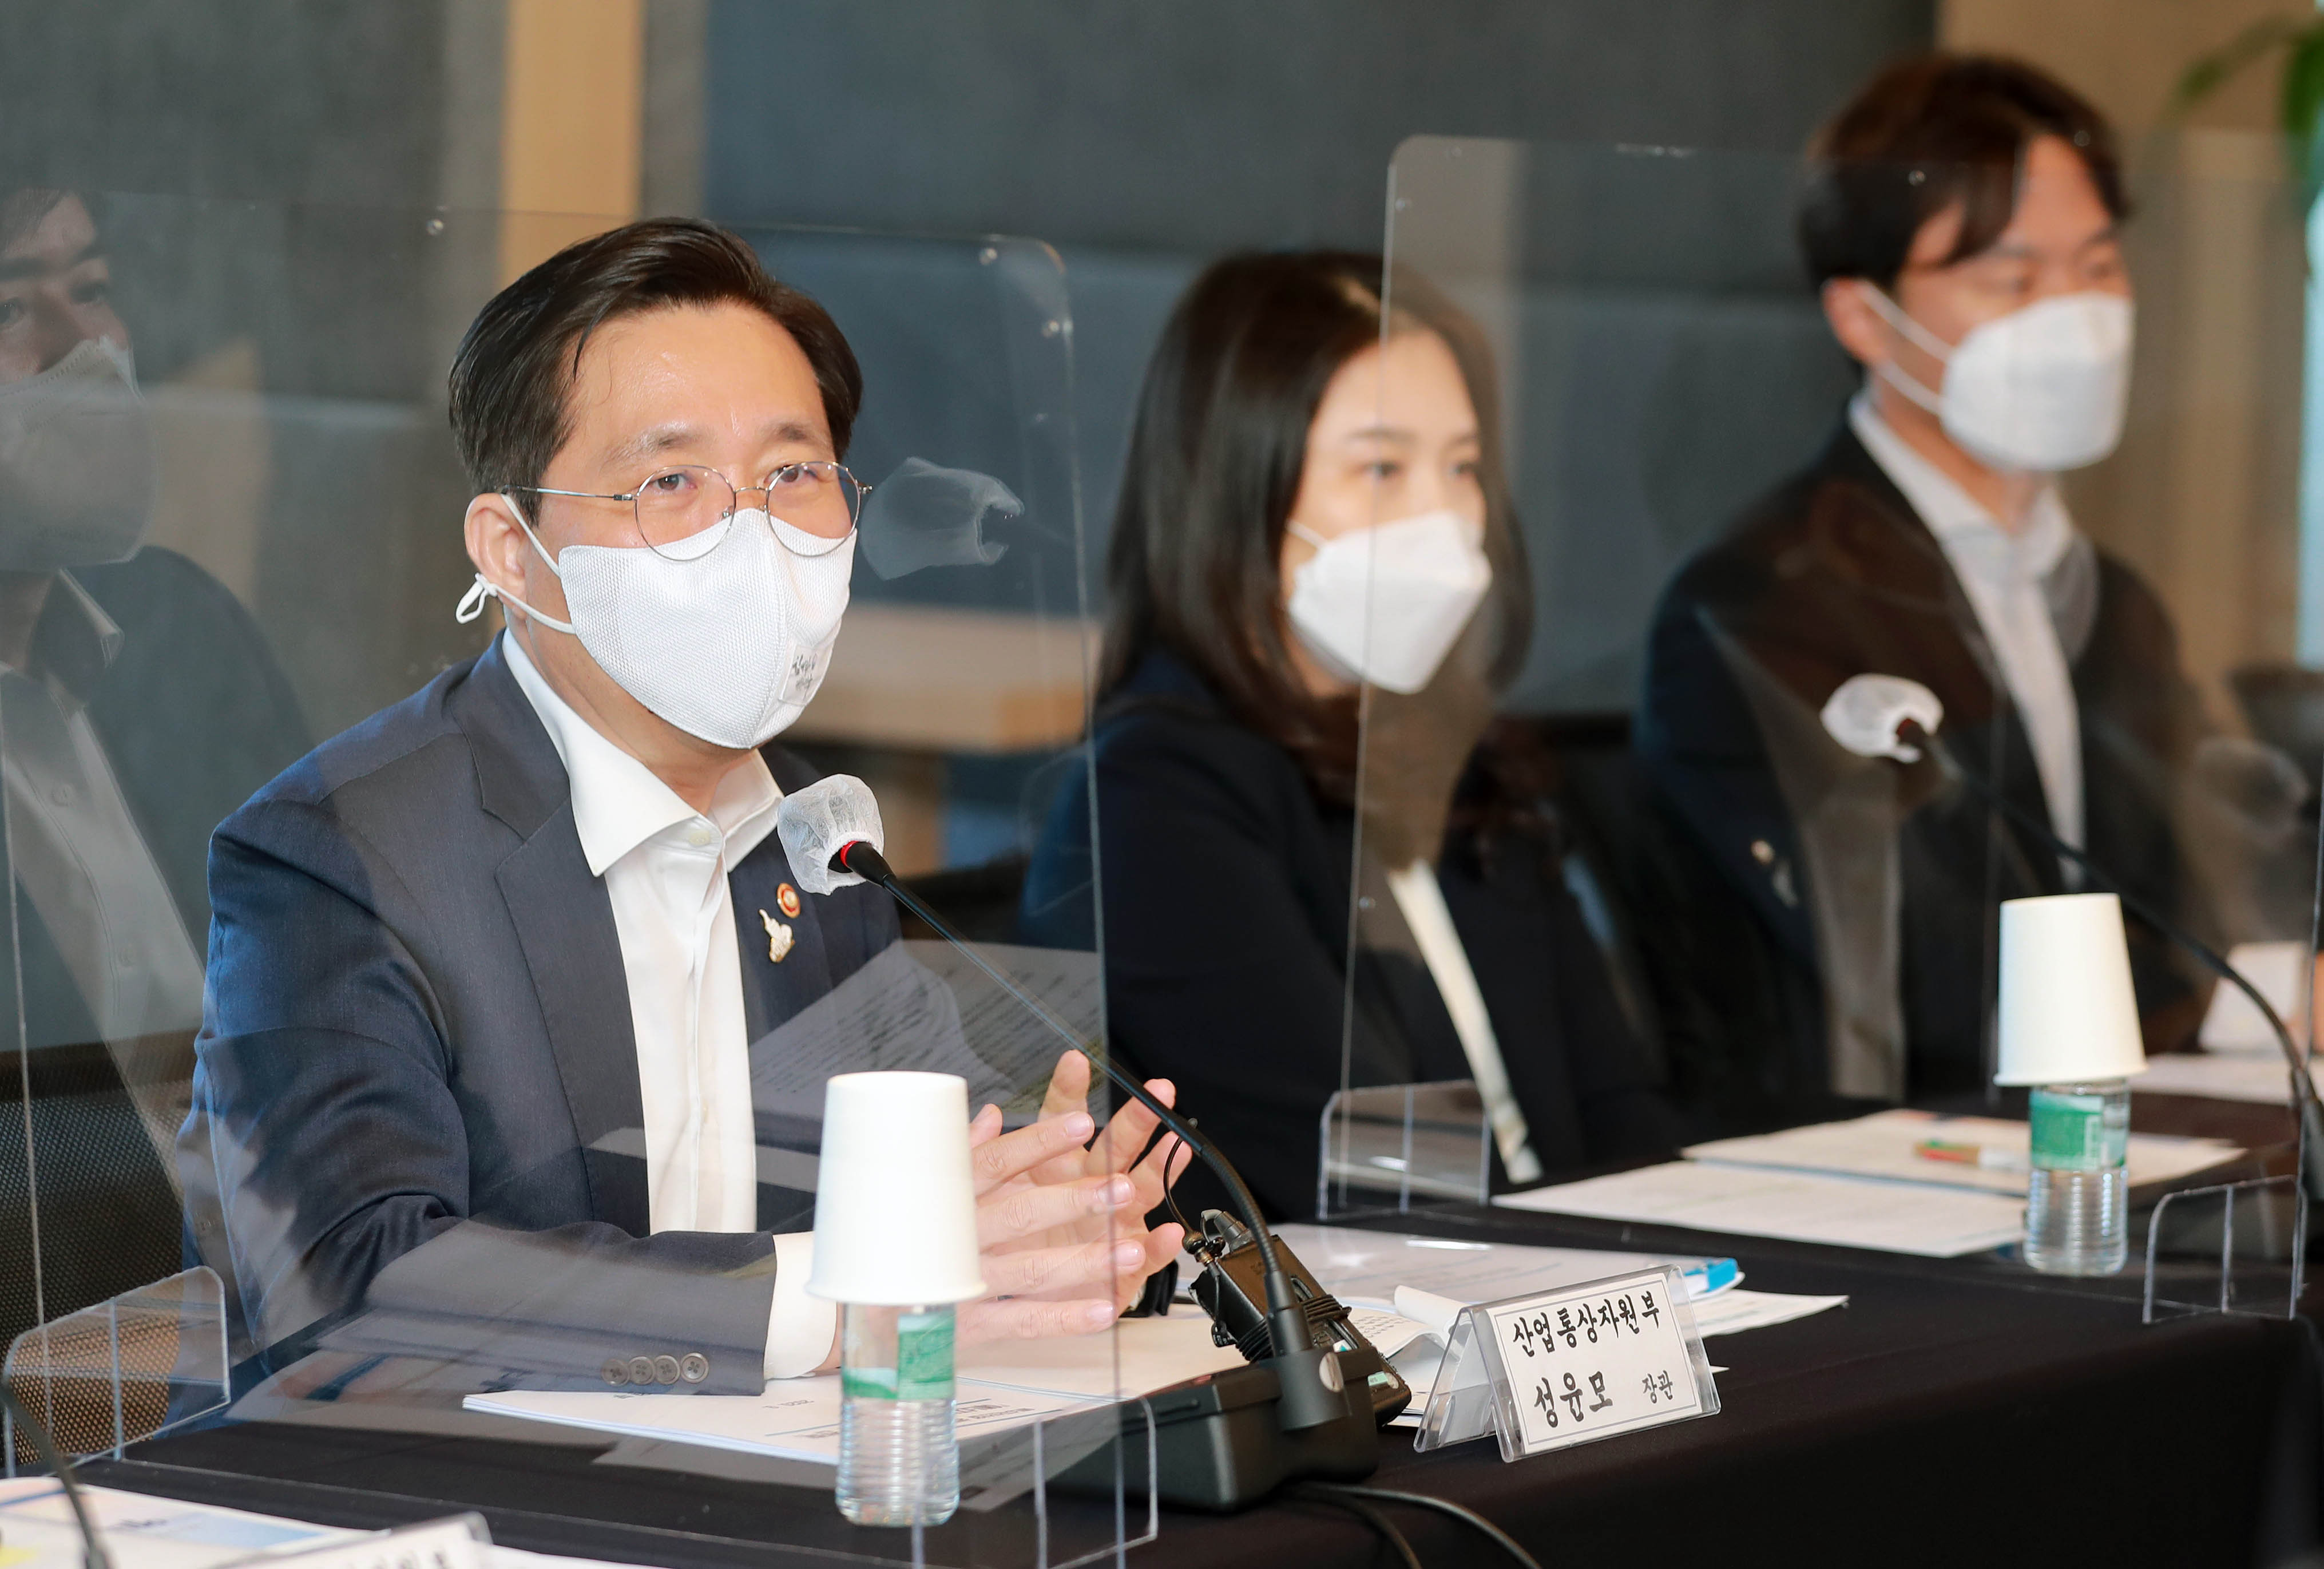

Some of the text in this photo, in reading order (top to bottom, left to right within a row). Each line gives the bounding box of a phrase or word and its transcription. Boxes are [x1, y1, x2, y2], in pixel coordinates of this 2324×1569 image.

[1513, 1291, 1660, 1357] 산업통상자원부
[1534, 1370, 1673, 1428] 성윤모 장관
